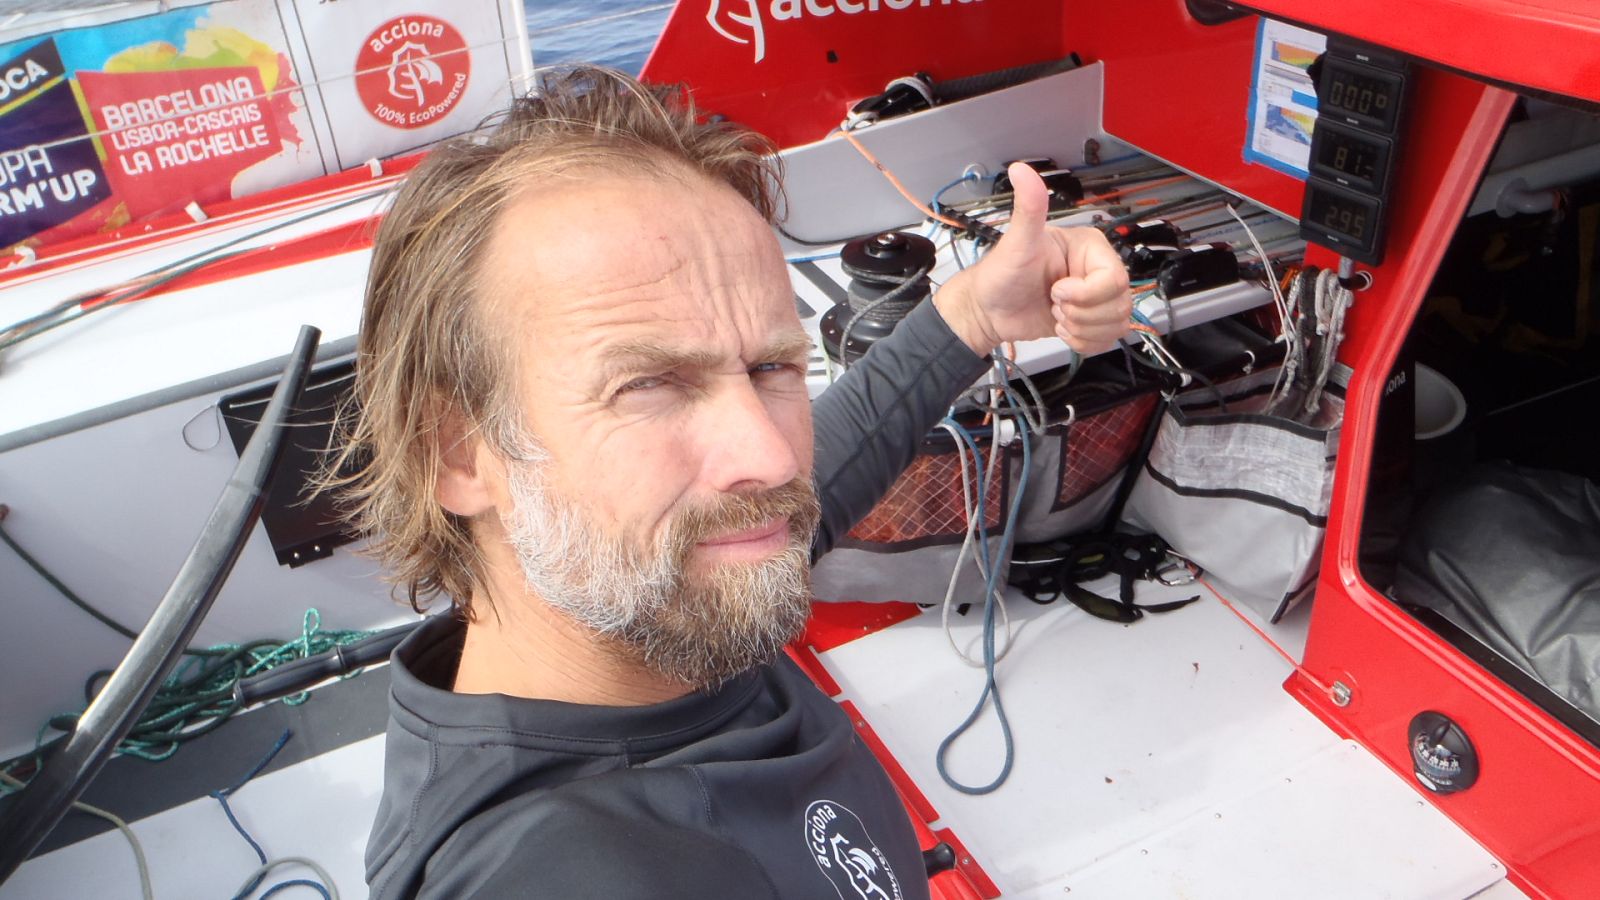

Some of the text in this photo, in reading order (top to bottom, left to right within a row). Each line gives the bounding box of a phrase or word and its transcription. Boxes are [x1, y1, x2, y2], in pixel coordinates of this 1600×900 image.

[370, 19, 445, 53] acciona
[101, 76, 255, 131] BARCELONA
[373, 72, 467, 125] 100% EcoPowered
[111, 103, 262, 150] LISBOA-CASCAIS
[119, 125, 270, 175] LA ROCHELLE
[808, 804, 838, 868] acciona
